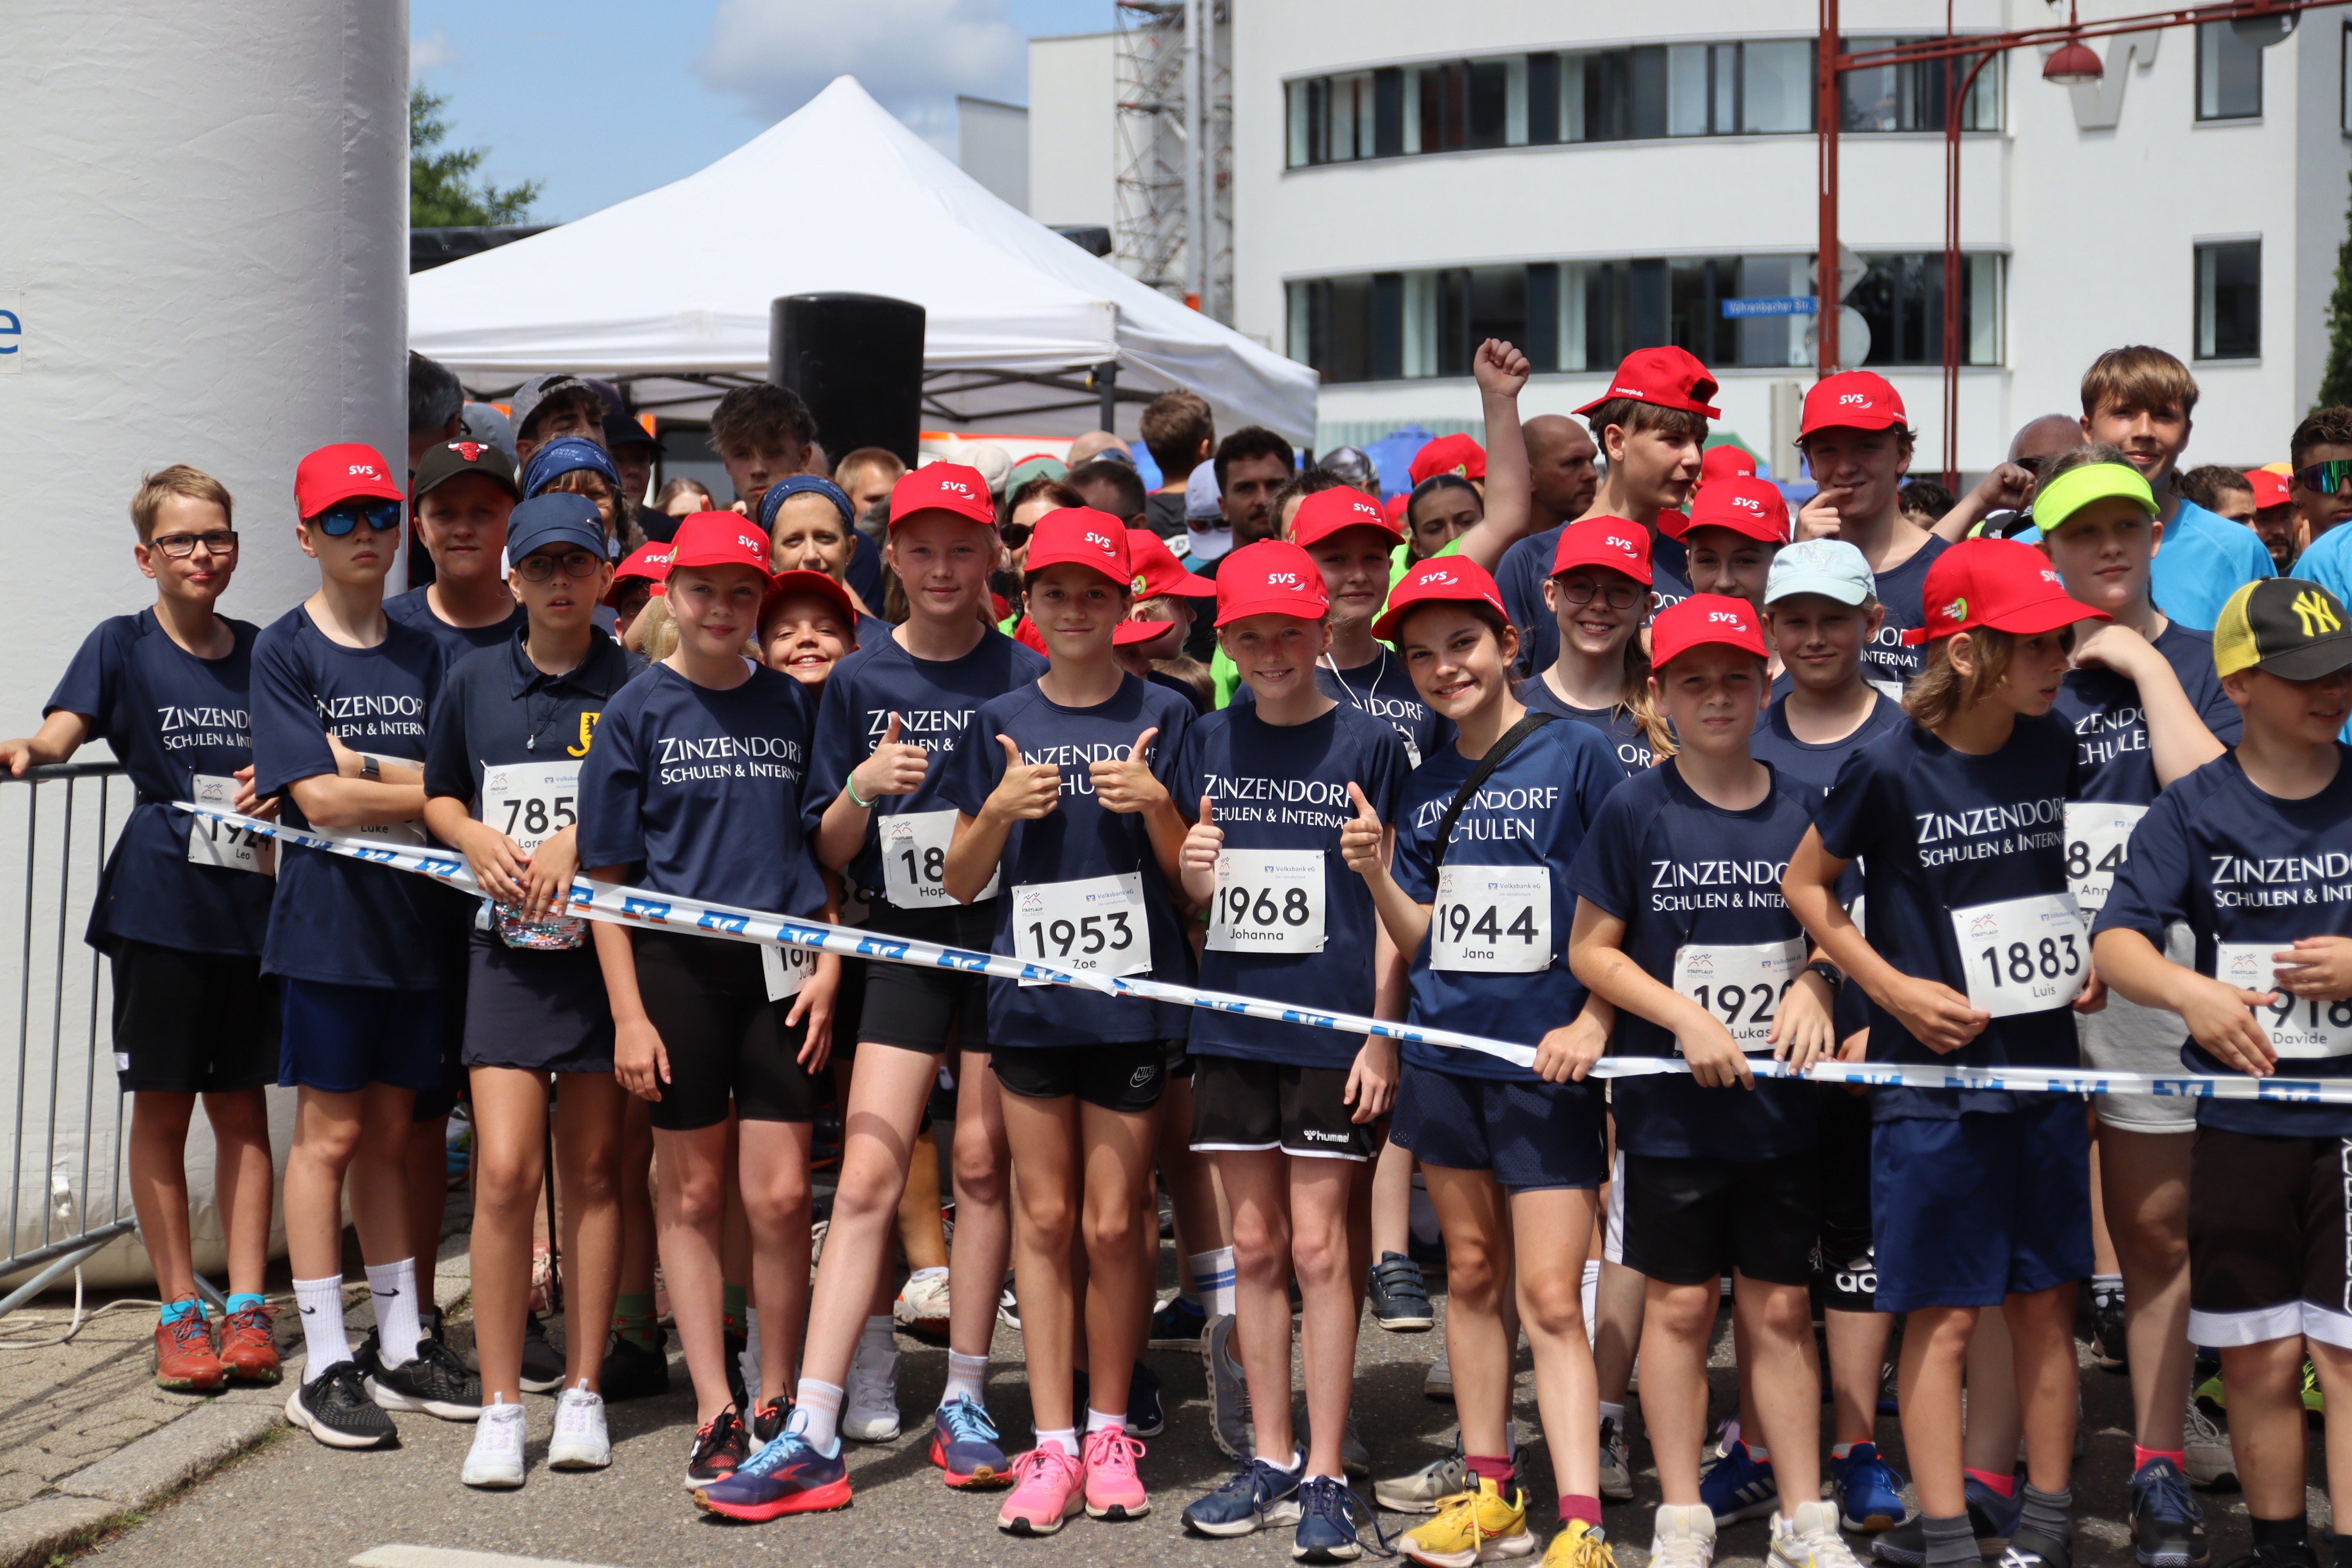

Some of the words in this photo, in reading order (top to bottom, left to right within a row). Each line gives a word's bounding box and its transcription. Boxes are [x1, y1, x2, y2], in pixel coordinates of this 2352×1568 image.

[1839, 394, 1864, 405] SVS
[349, 465, 373, 475] SVS
[941, 481, 967, 492] SVS
[1353, 503, 1376, 515] SVS
[1732, 497, 1760, 509] SVS
[738, 535, 759, 552] SVS
[1085, 532, 1111, 548] SVS
[1606, 536, 1632, 550] SVS
[644, 555, 668, 563] SVS
[1268, 573, 1296, 584] SVS
[1419, 571, 1447, 585] SVS
[1709, 612, 1737, 623] SVS
[2291, 590, 2341, 636] NY
[1861, 648, 1919, 668] INTERNAT
[158, 706, 251, 732] ZINZEND
[367, 723, 377, 735] &
[226, 735, 234, 746] &
[658, 737, 802, 764] ZINZENDORF
[661, 763, 732, 785] SCHULEN
[735, 764, 746, 777] &
[749, 762, 802, 784] INTERNT
[503, 796, 576, 835] 785
[1212, 807, 1262, 822] CHULEN
[1266, 809, 1277, 822] &
[1448, 818, 1534, 843] CHULEN
[236, 848, 250, 860] Leo
[1919, 841, 2000, 868] SCHULEN
[2004, 839, 2014, 855] &
[2211, 852, 2352, 884] ZINZEND
[1097, 890, 1126, 899] Volksbank
[2214, 889, 2298, 908] SCHULEN
[2304, 888, 2317, 904] &
[1219, 886, 1309, 926] 1968
[1652, 893, 1727, 911] SCHULEN
[1733, 893, 1743, 908] &
[1439, 904, 1539, 945] 1944
[1029, 911, 1133, 959] 1953
[1230, 929, 1284, 940] Johanna
[1971, 930, 1999, 938] STADTLAUF
[1462, 948, 1494, 959] Jana
[1072, 959, 1096, 969] Zoe
[1773, 957, 1796, 965] Volksbank
[1981, 934, 2081, 988] 1883
[2033, 983, 2056, 998] Luis
[2273, 1032, 2327, 1045] Davide
[1317, 1130, 1349, 1143] hummel
